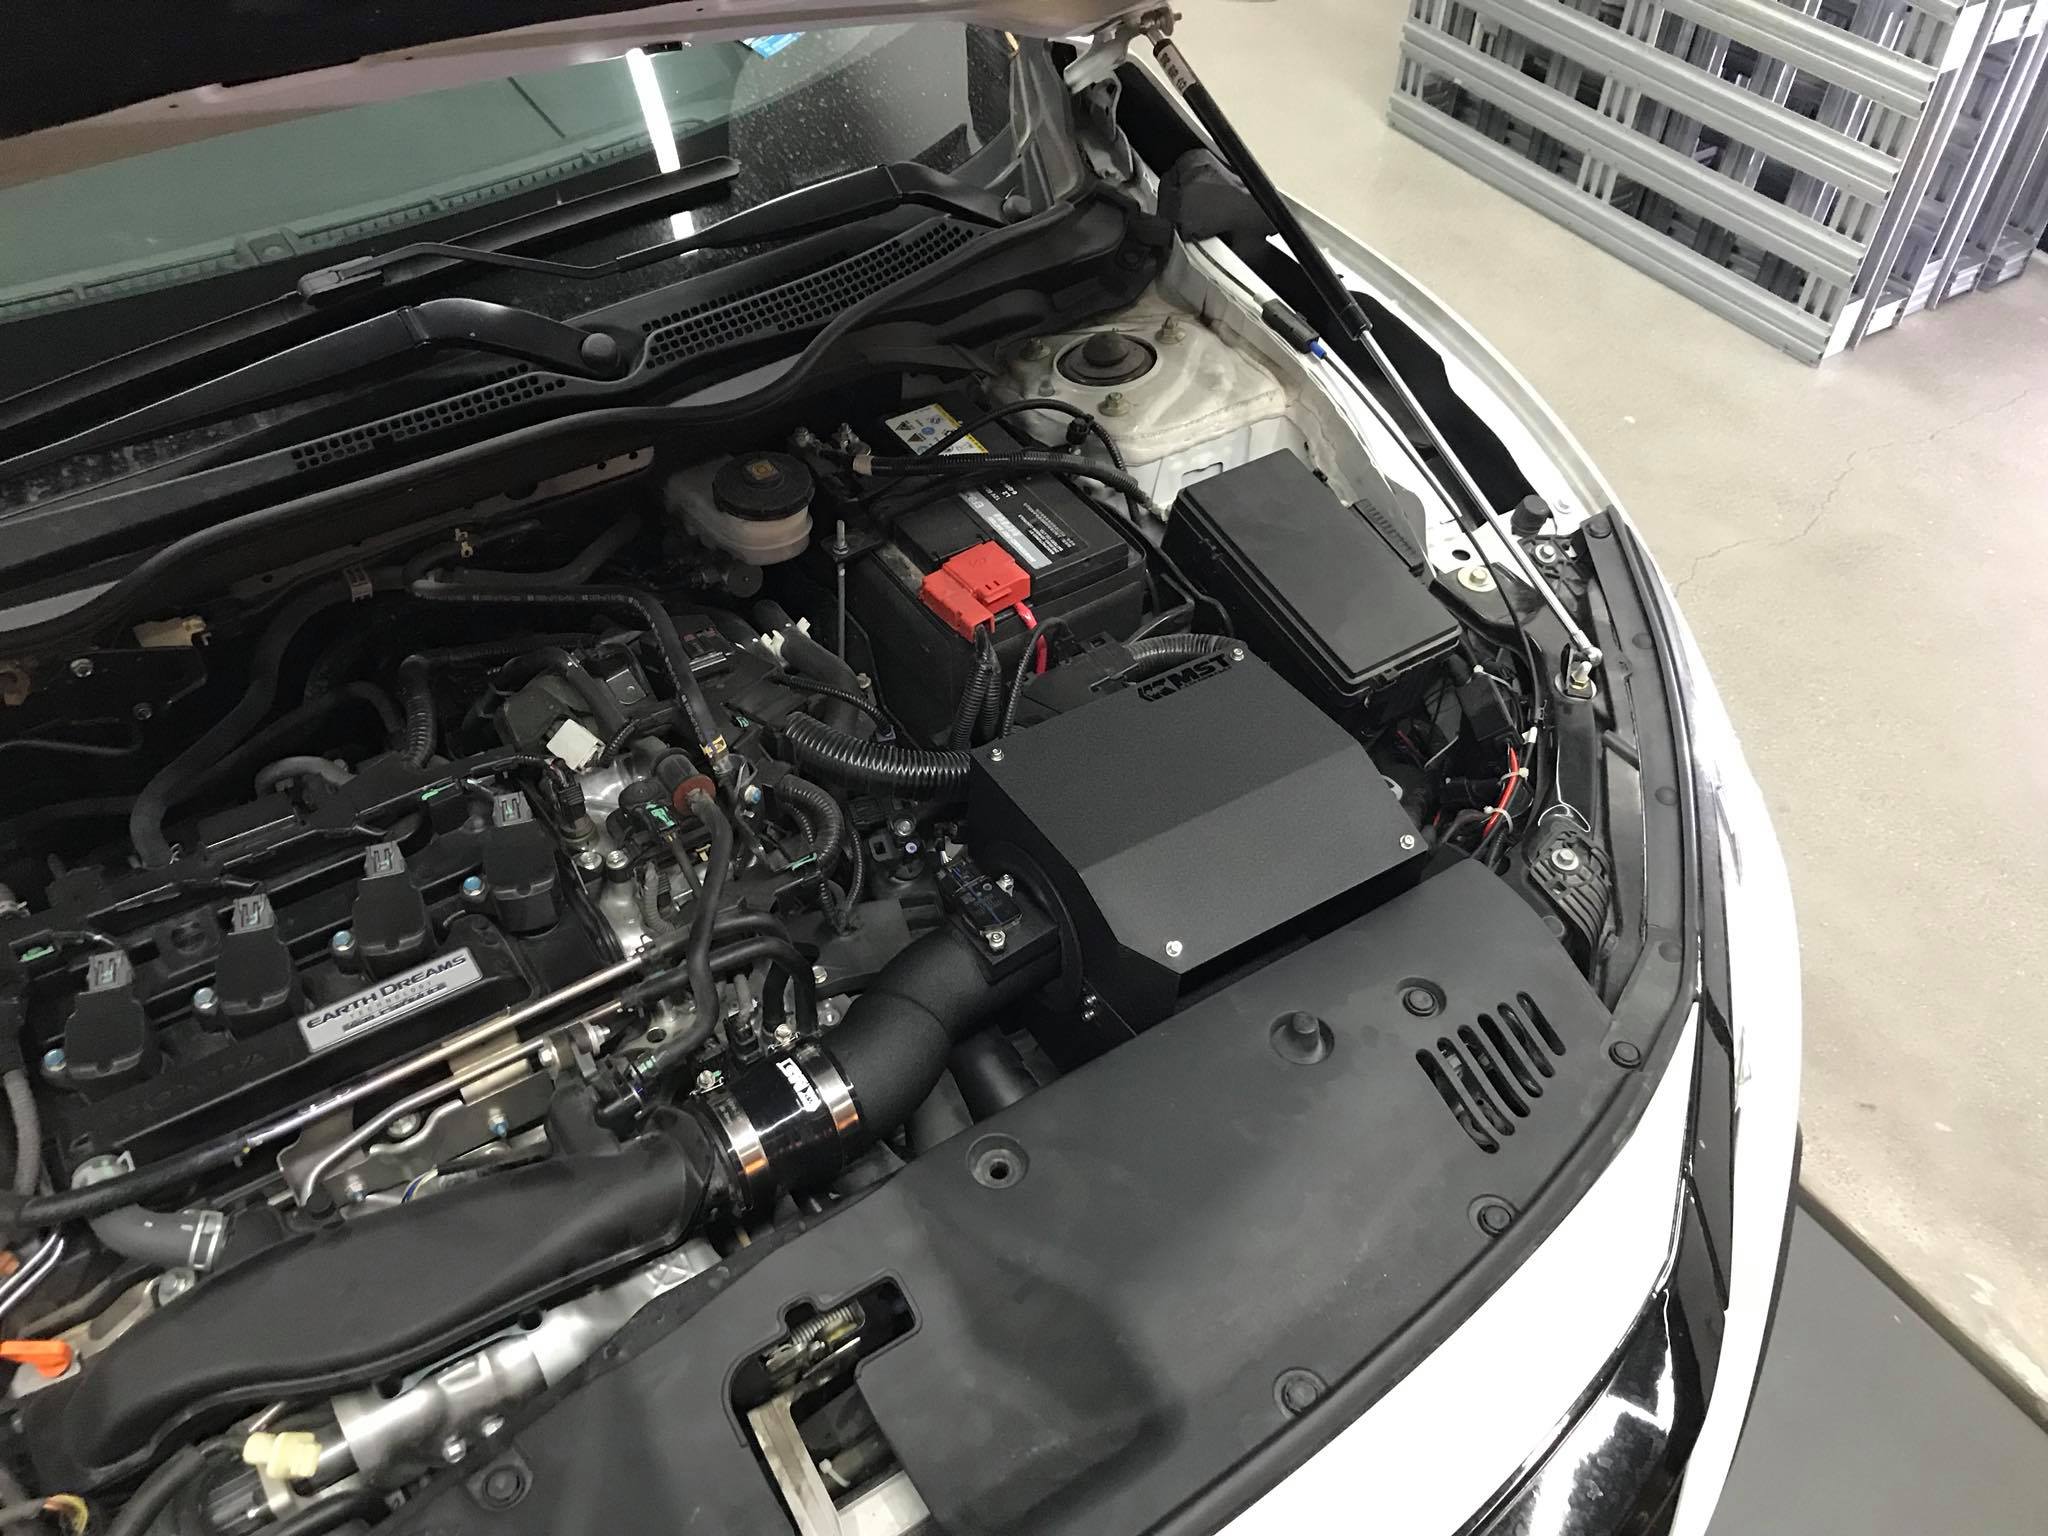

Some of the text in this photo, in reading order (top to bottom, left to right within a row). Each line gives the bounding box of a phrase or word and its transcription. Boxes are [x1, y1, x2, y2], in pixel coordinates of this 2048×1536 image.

[1166, 653, 1231, 690] MST
[306, 992, 378, 1030] EARTH
[379, 954, 467, 998] DREAMS
[349, 980, 433, 1020] TECHNOLOGY
